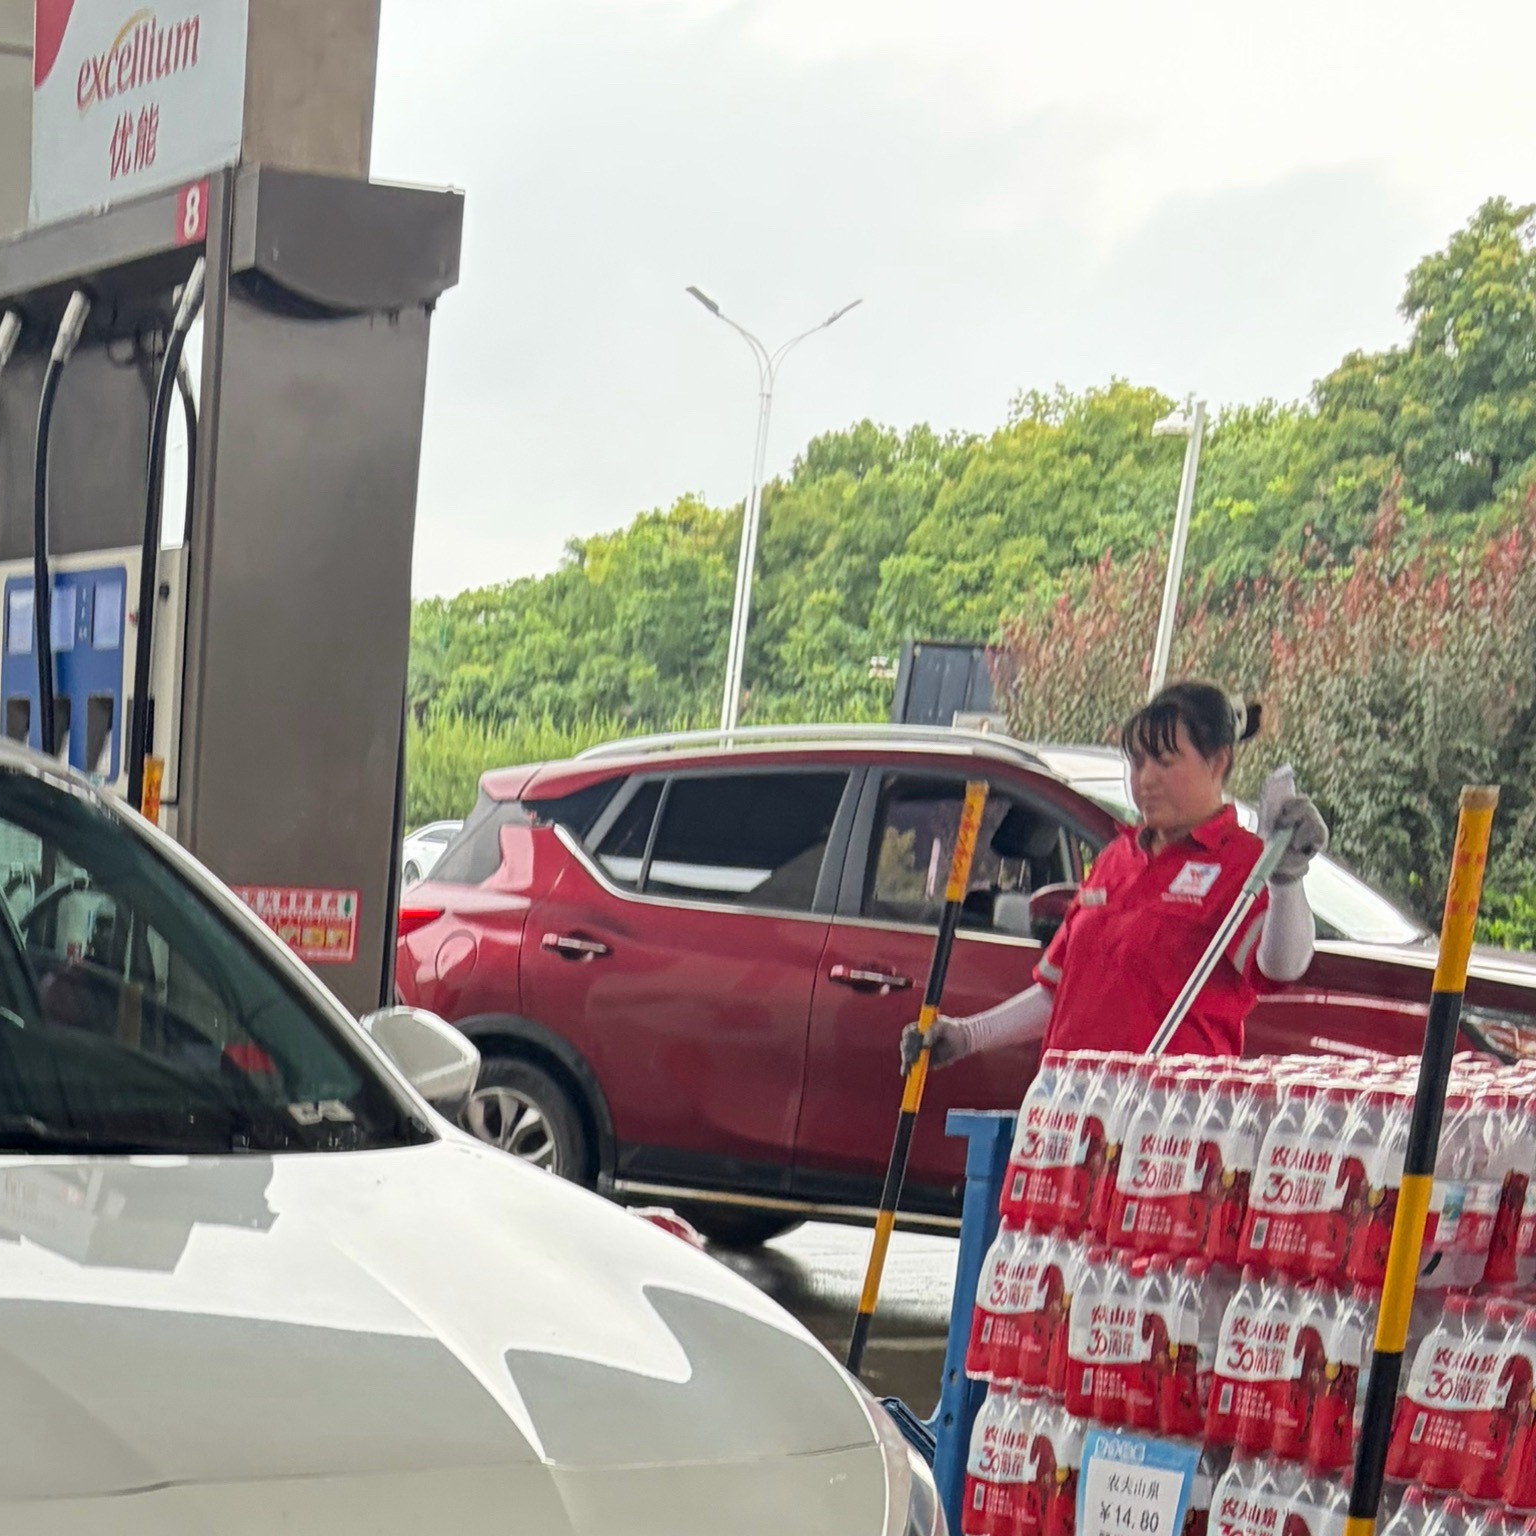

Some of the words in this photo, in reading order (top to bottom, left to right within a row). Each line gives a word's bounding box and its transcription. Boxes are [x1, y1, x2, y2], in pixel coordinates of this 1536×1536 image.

[76, 14, 200, 112] excellium
[109, 101, 160, 182] 优能
[182, 184, 201, 240] 8
[1107, 1471, 1160, 1501] 农夫山泉
